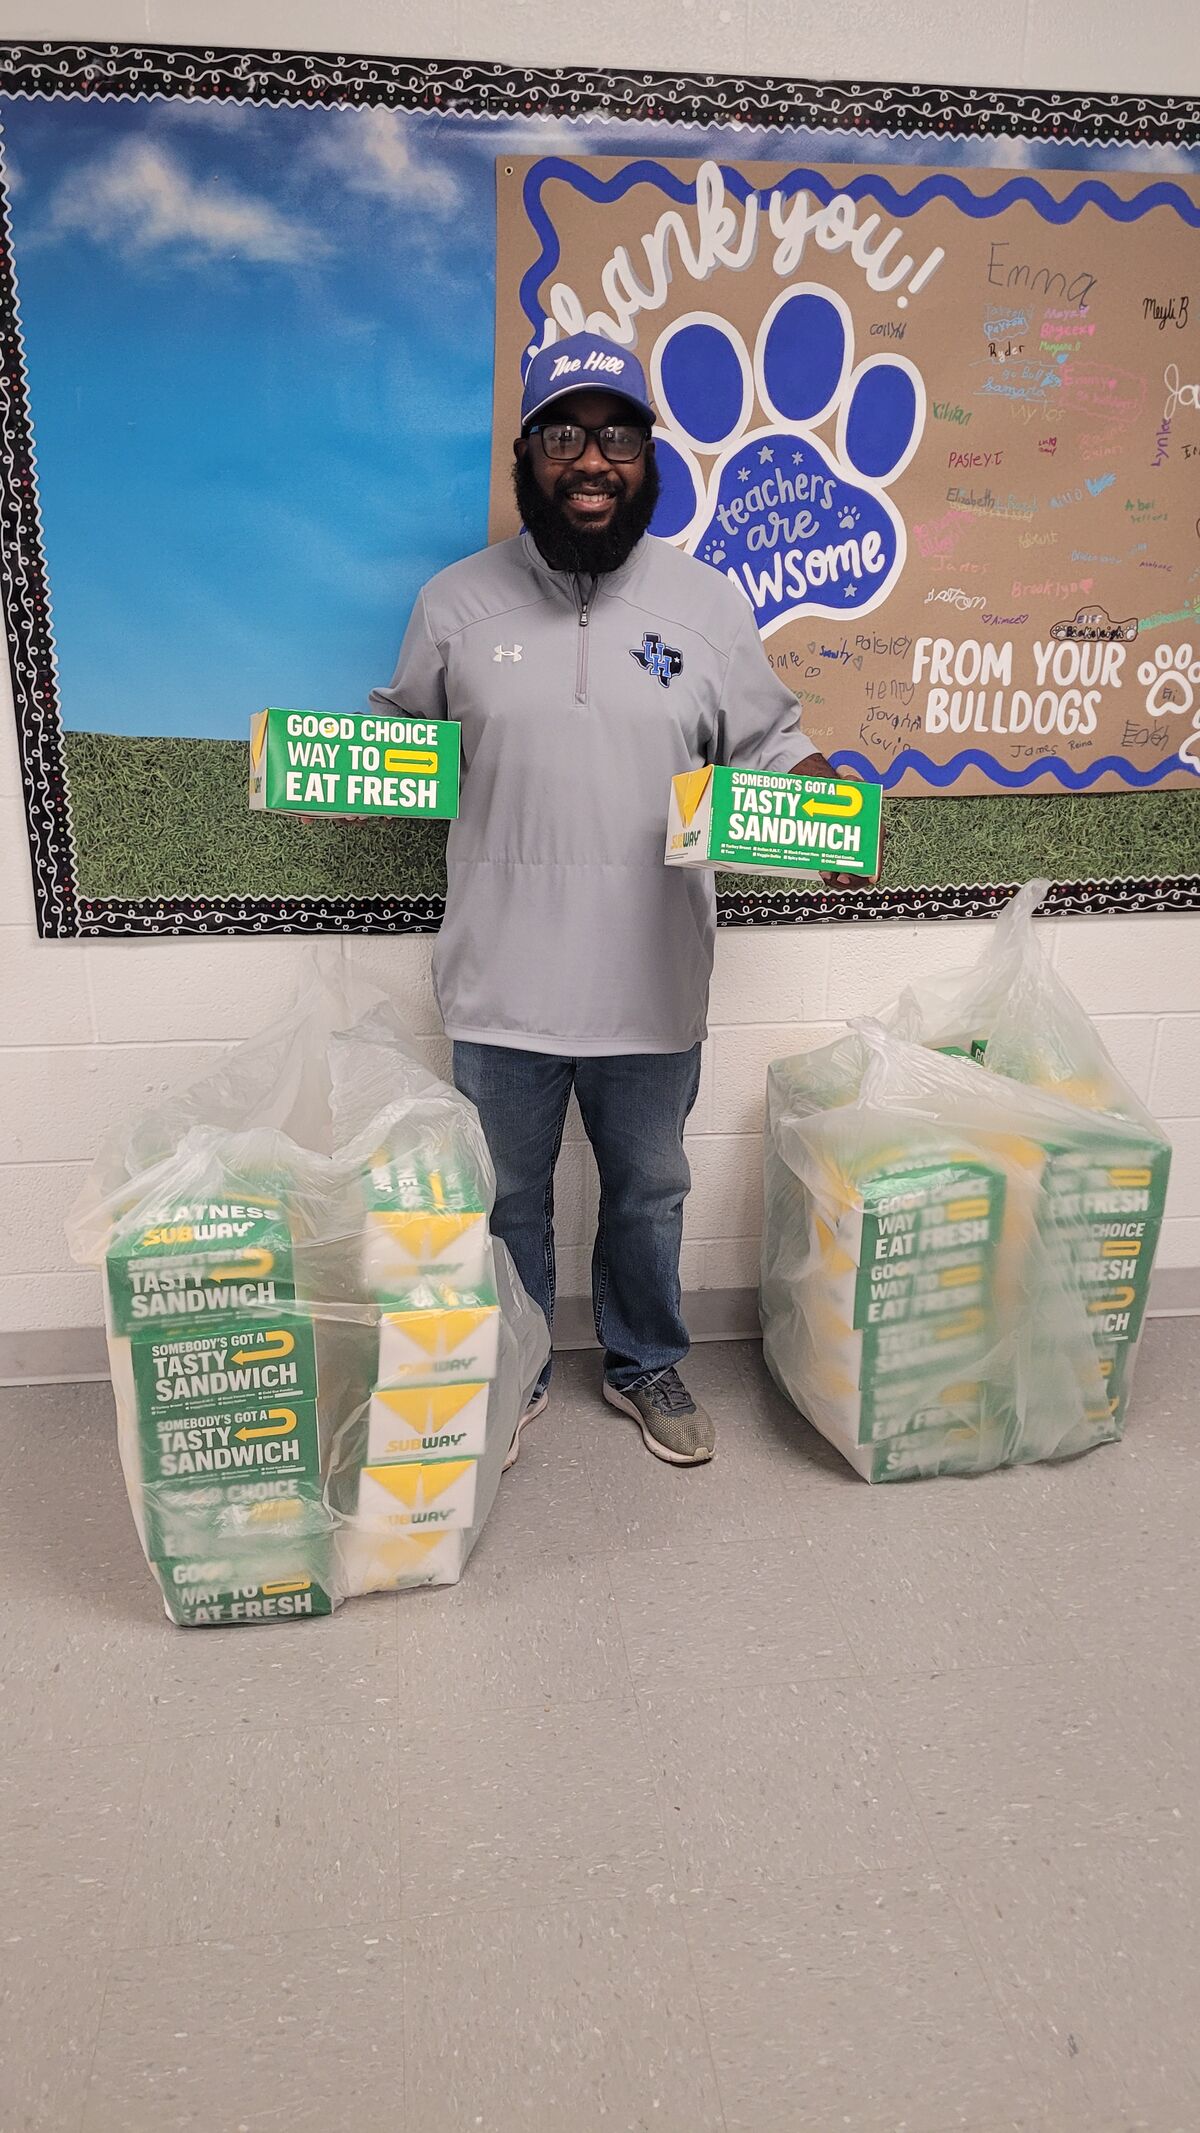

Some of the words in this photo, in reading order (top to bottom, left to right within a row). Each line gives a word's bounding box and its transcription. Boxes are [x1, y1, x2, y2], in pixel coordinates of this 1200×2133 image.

[769, 189, 945, 309] you!
[988, 242, 1096, 309] Emma
[549, 355, 581, 381] The
[583, 350, 625, 375] Hill
[988, 341, 1024, 363] Ryder
[715, 467, 837, 536] teachers
[946, 487, 995, 508] Elizabeth
[746, 509, 820, 552] are
[855, 631, 912, 659] Paisley
[912, 637, 1013, 686] FROM
[1033, 641, 1126, 688] YOUR
[925, 687, 1102, 735] BULLDOGS
[287, 714, 355, 740] GOOD
[361, 719, 438, 746] CHOICE
[287, 740, 341, 769] WAY
[348, 745, 380, 772] TO
[286, 771, 340, 803] EAT
[347, 775, 438, 809] FRESH
[732, 772, 802, 792] SOMEBODY'S
[804, 780, 826, 794] GOT
[827, 783, 836, 795] A
[731, 786, 801, 817] TASTY
[728, 813, 861, 852] SANDWICH
[143, 1221, 255, 1247] SUBWAY
[877, 1212, 917, 1236] WAY
[875, 1233, 916, 1260] EAT
[130, 1266, 205, 1294] TASTY
[131, 1281, 276, 1319] SANDWICH
[868, 1298, 909, 1323] EAT
[152, 1337, 228, 1357] SOMEBODY'S
[231, 1333, 255, 1346] GOT
[256, 1332, 265, 1343] A
[153, 1350, 227, 1378] TASTY
[155, 1362, 297, 1402] SANDWICH
[156, 1413, 231, 1433] SOMEBODY'S
[234, 1410, 258, 1423] GOT
[259, 1409, 268, 1420] A
[158, 1426, 232, 1453] TASTY
[387, 1432, 467, 1453] SUBWAY
[160, 1439, 299, 1477] SANDWICH
[227, 1479, 299, 1503] CHOICE
[229, 1592, 313, 1620] FRESH
